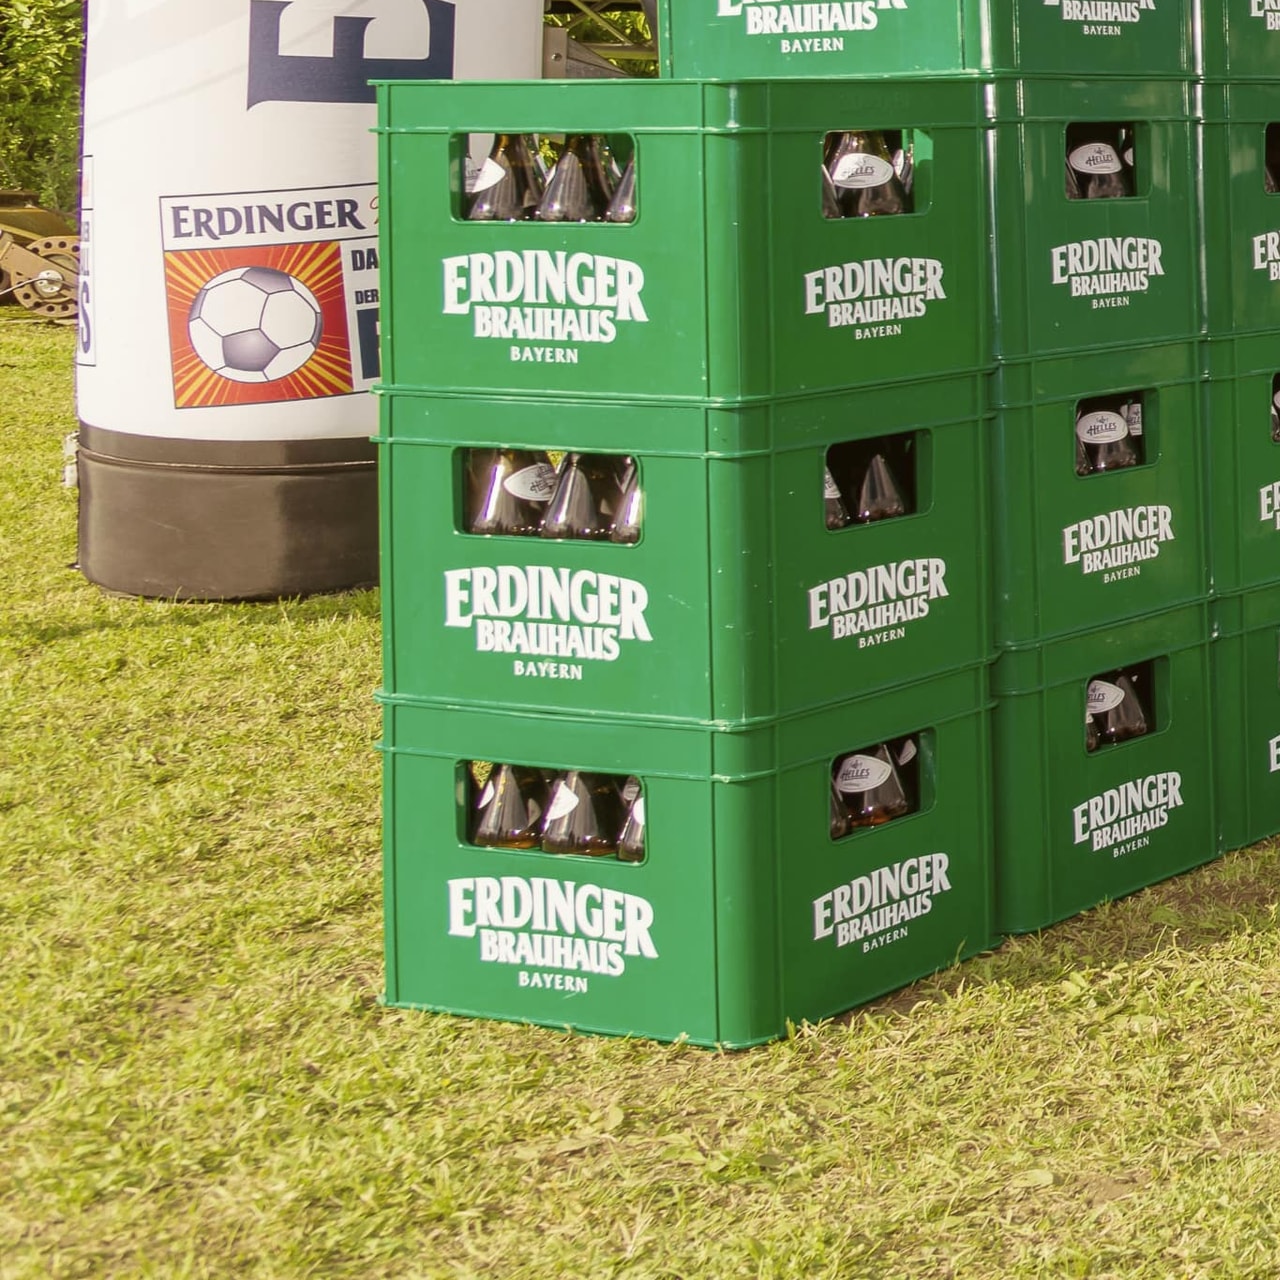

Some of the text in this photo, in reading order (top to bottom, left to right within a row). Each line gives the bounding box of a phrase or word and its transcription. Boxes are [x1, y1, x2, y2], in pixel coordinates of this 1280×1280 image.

[747, 0, 878, 35] BRAUHAUS
[1062, 0, 1140, 22] BRAUHAUS
[1083, 24, 1120, 35] BAYERN
[781, 37, 843, 53] BAYERN
[1085, 154, 1114, 166] HELLES
[171, 198, 361, 242] ERDINGER
[351, 250, 379, 272] DA
[1051, 236, 1165, 284] ERDINGER
[442, 249, 648, 321] ERDINGER
[1071, 269, 1149, 297] BRAUHAUS
[1092, 295, 1129, 309] BAYERN
[474, 305, 616, 342] BRAUHAUS
[510, 346, 577, 363] BAYERN
[1088, 422, 1116, 436] HELLES
[447, 876, 657, 957] ERDINGER
[481, 929, 625, 975] BRAUHAUS
[519, 971, 587, 993] BAYERN
